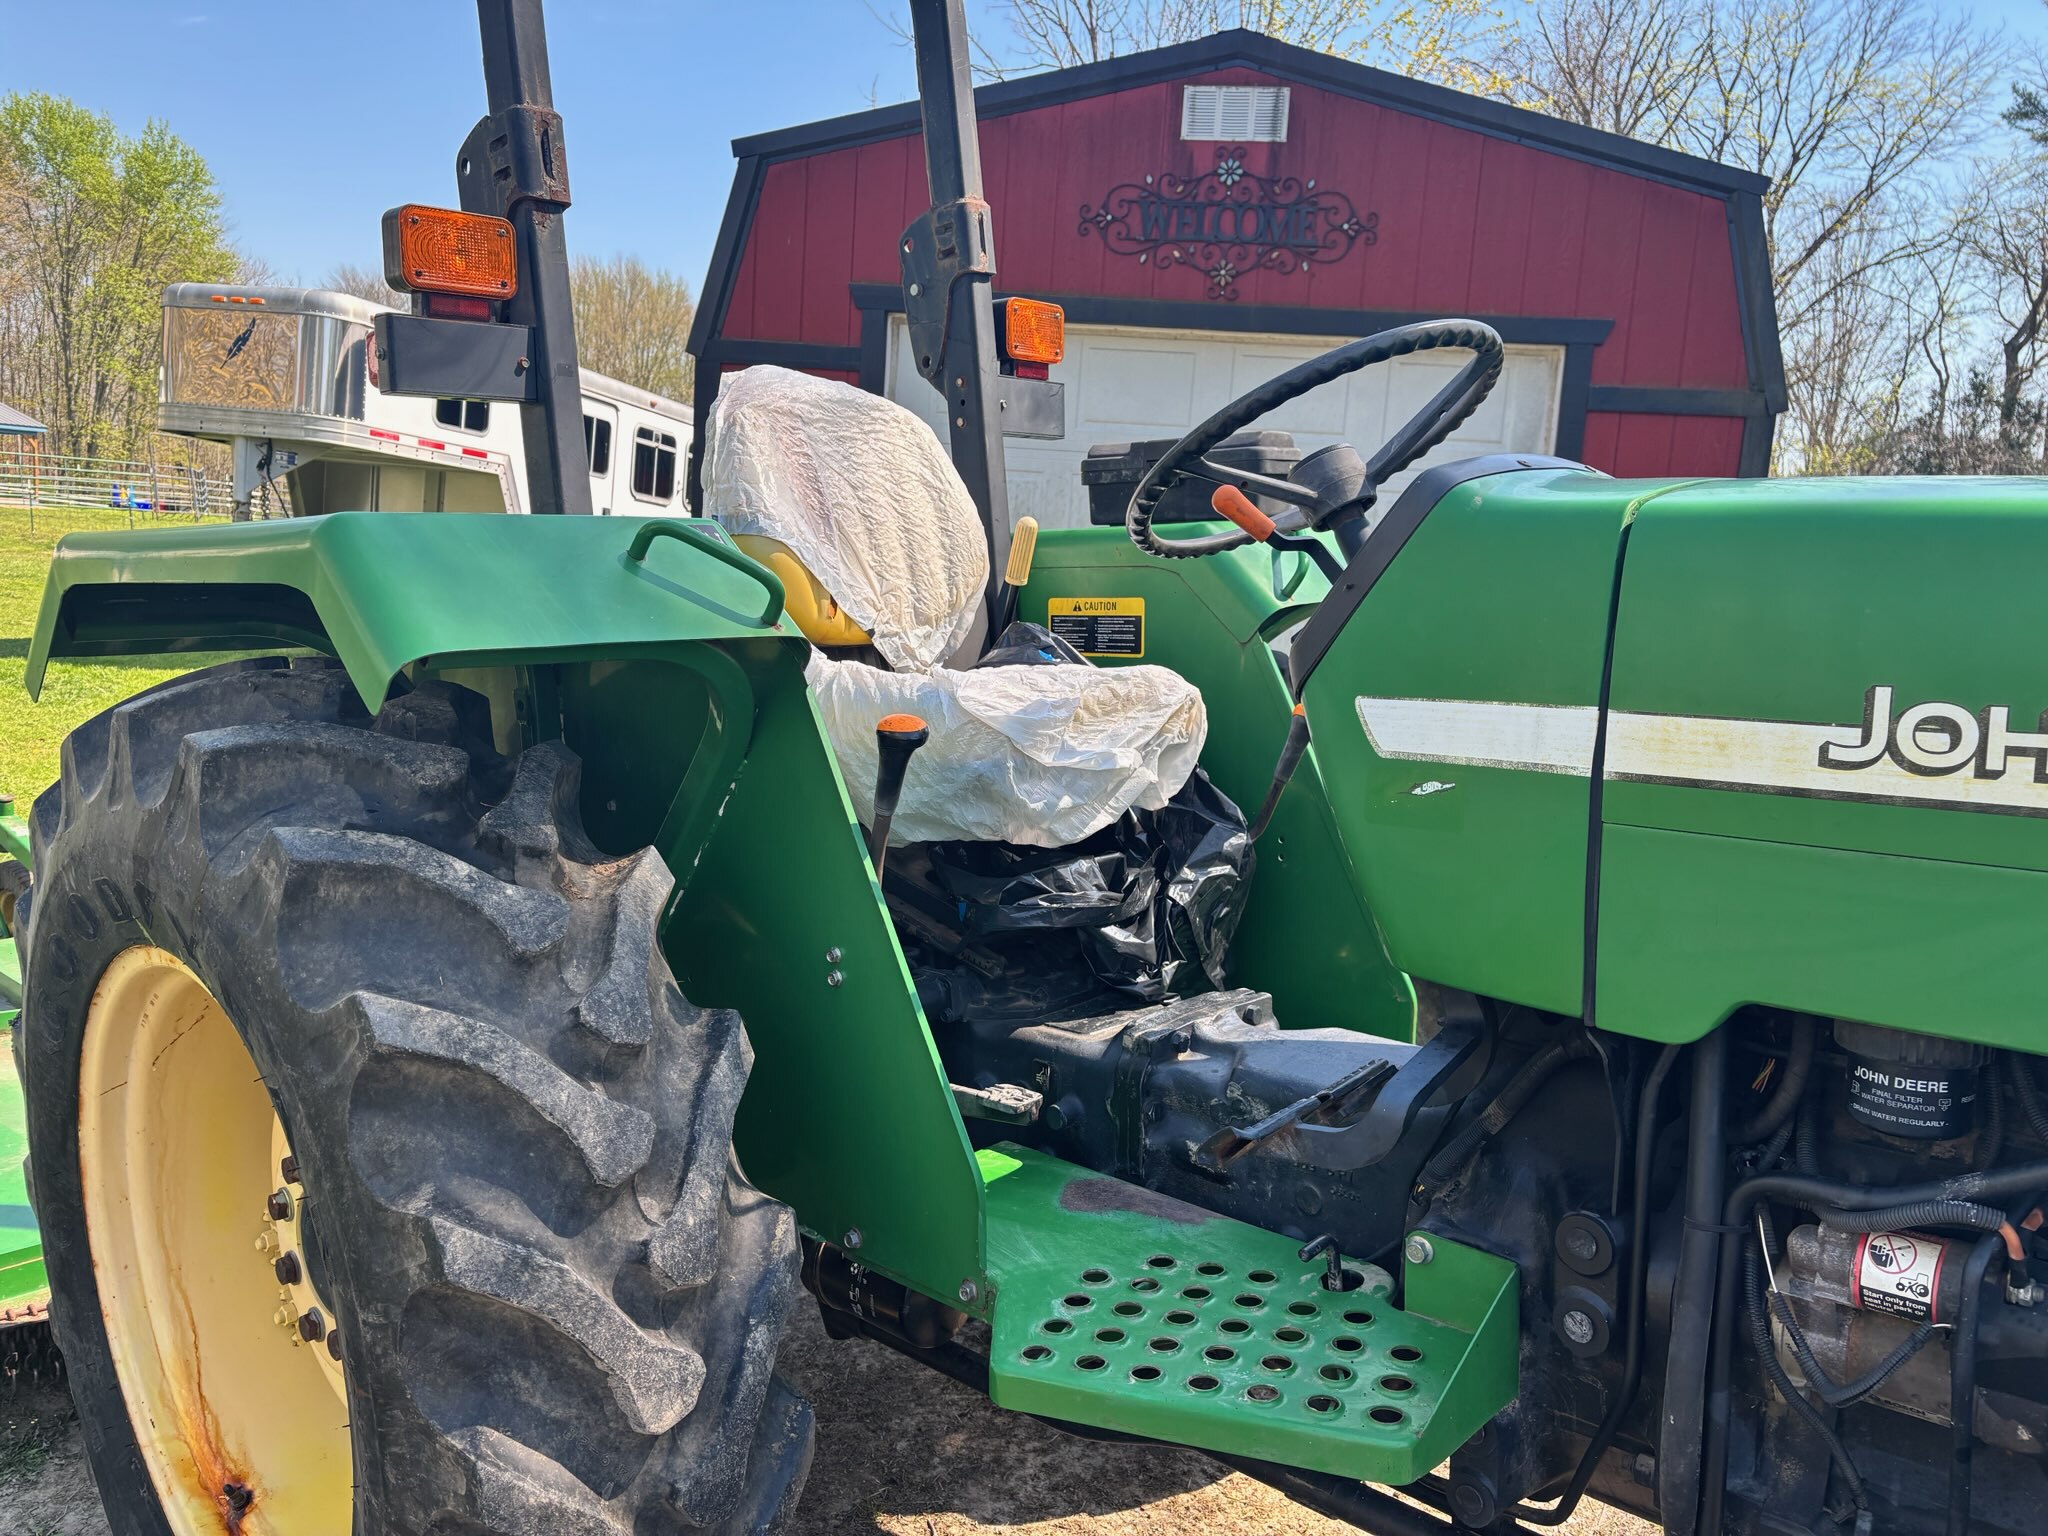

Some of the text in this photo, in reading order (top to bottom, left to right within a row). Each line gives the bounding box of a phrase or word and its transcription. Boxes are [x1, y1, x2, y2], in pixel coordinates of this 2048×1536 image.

[1138, 200, 1319, 246] WELCOME
[1084, 601, 1117, 611] CAUTION
[1818, 685, 2048, 784] JOH
[1854, 1065, 1949, 1093] JOHN DEERE
[1861, 1092, 1936, 1112] WATER SEPARATOR
[1871, 1088, 1923, 1104] FINAL FILTER
[1871, 1110, 1897, 1122] WATER
[1863, 1288, 1926, 1311] Start only from
[1863, 1296, 1881, 1305] seat
[1893, 1304, 1913, 1313] park
